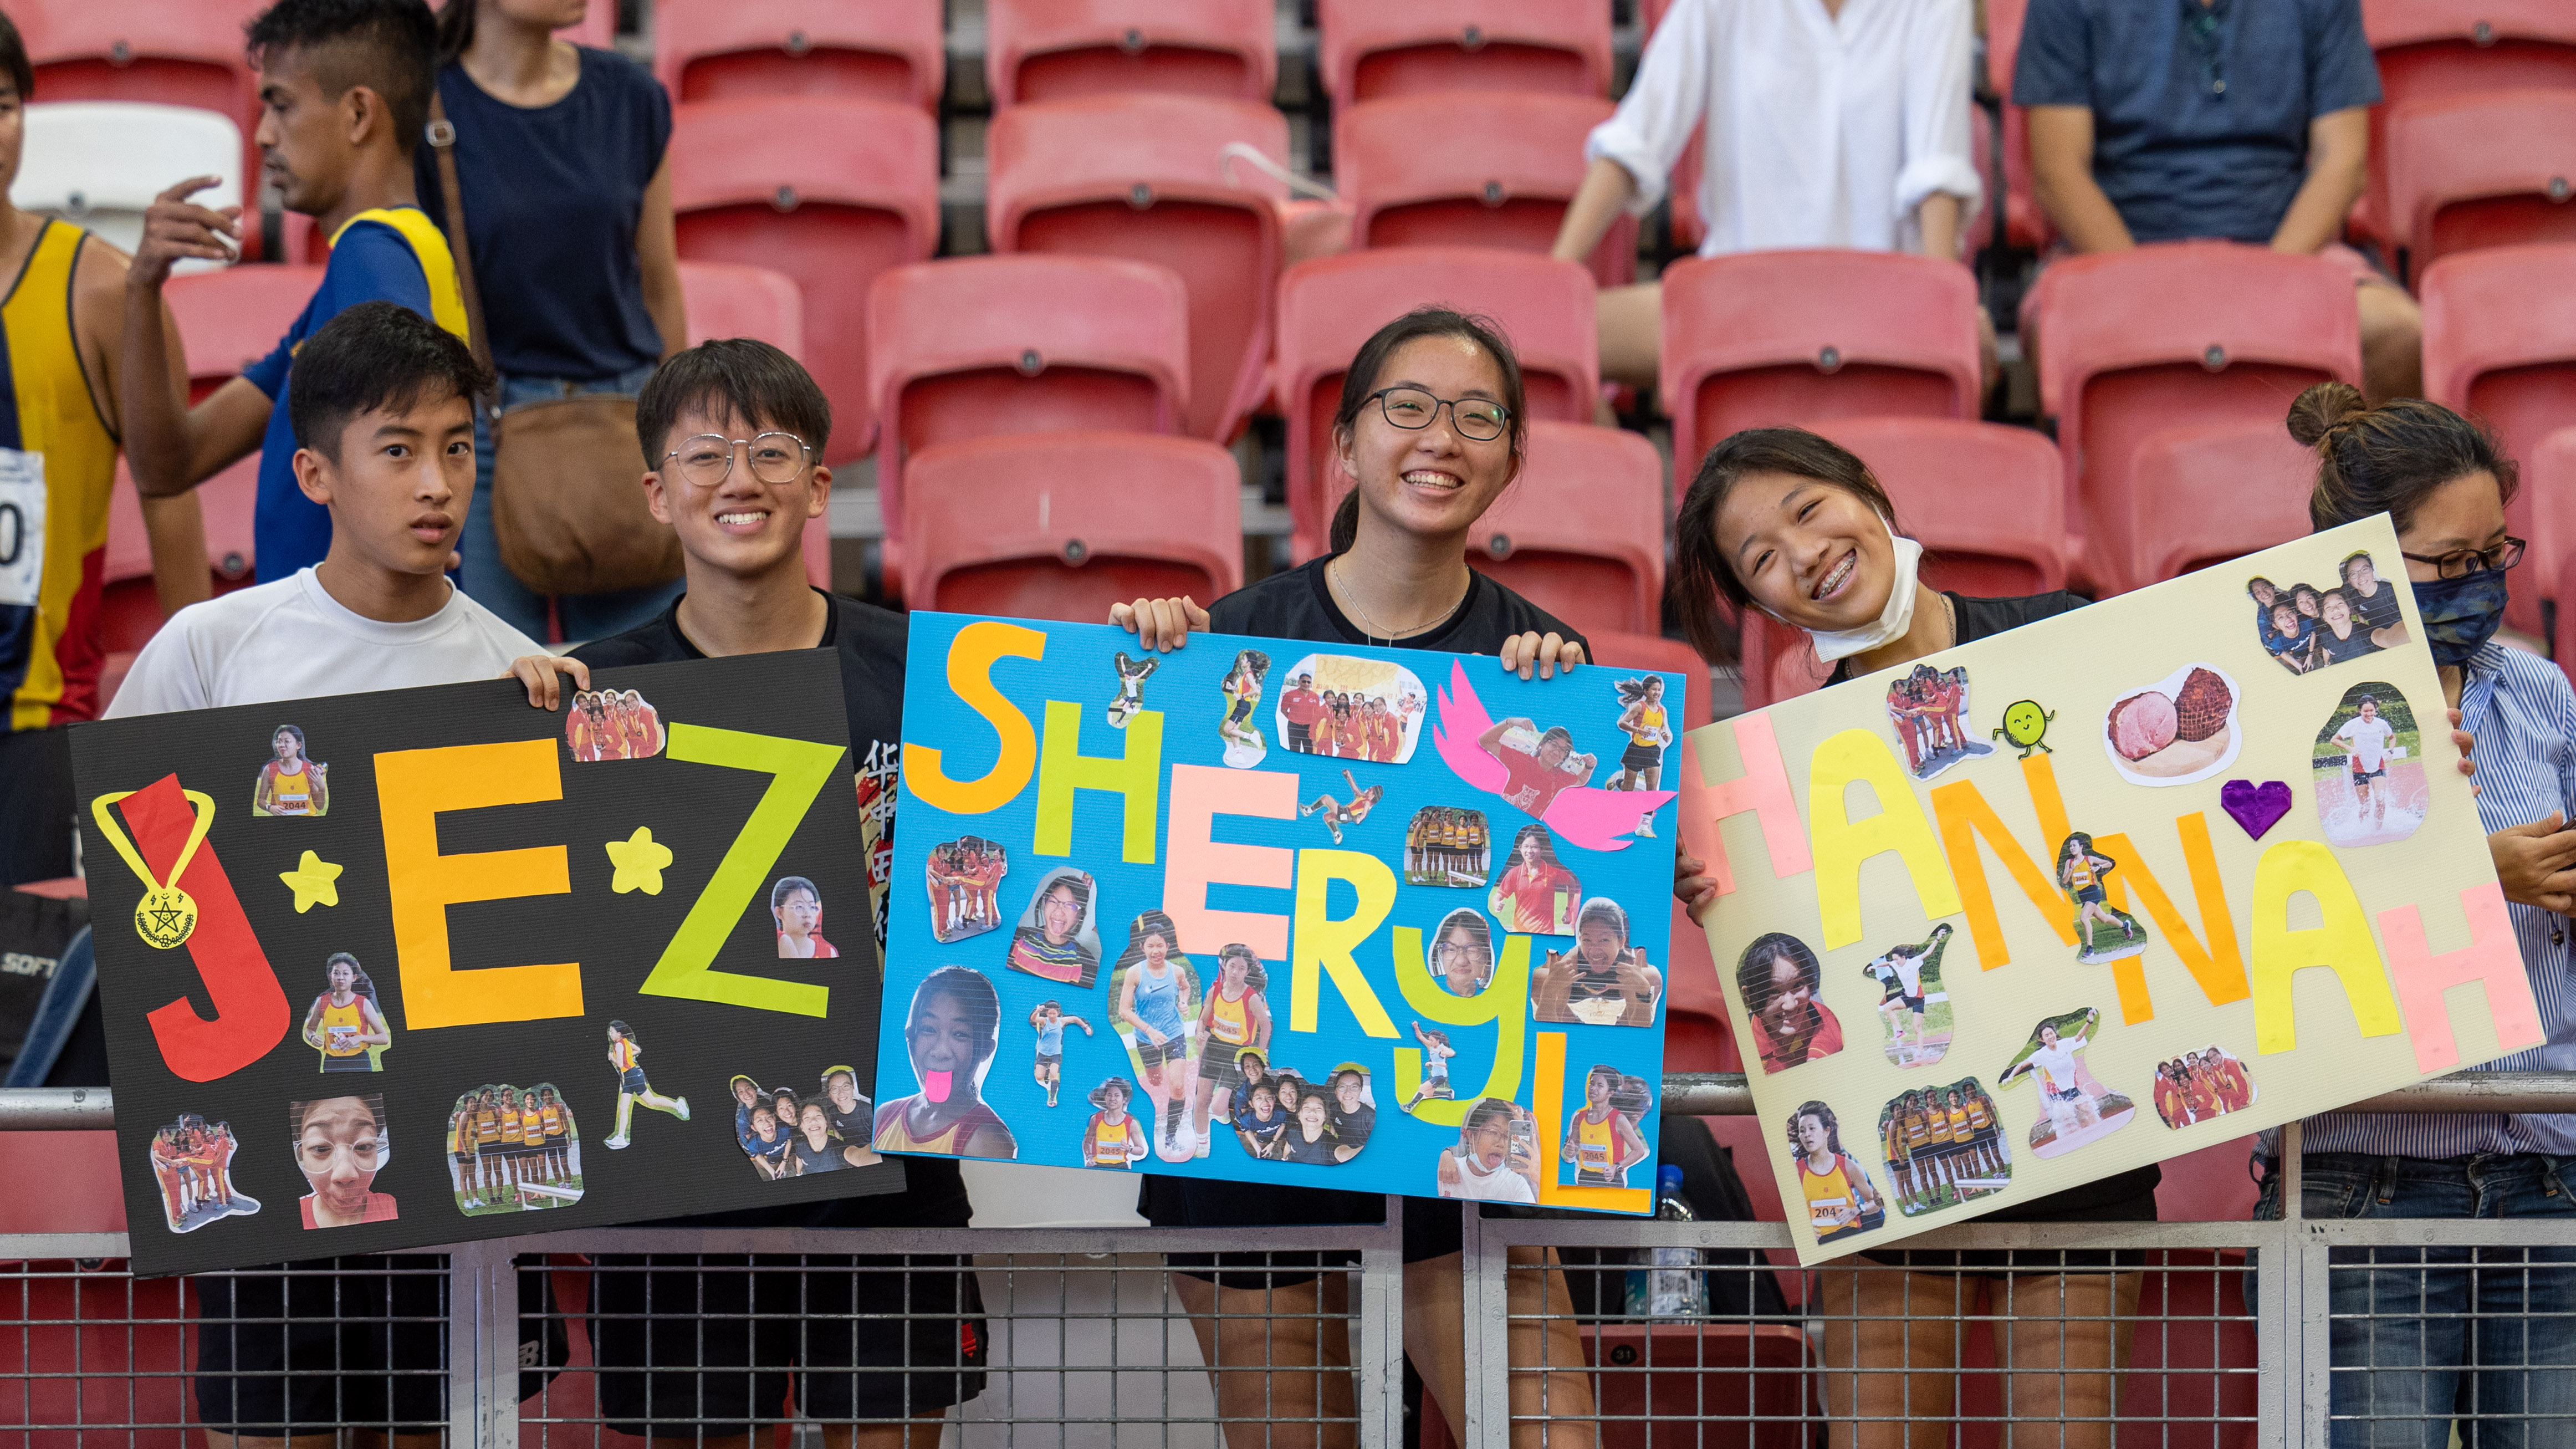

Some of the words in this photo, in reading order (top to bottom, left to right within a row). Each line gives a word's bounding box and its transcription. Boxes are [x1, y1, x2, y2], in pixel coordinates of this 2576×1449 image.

[283, 802, 306, 810] 2044
[1678, 711, 2543, 1075] HANNAH
[116, 721, 847, 1083] JEZ
[1216, 1022, 1238, 1034] 2045
[1585, 1152, 1605, 1161] 2045
[1815, 1207, 1844, 1218] 204
